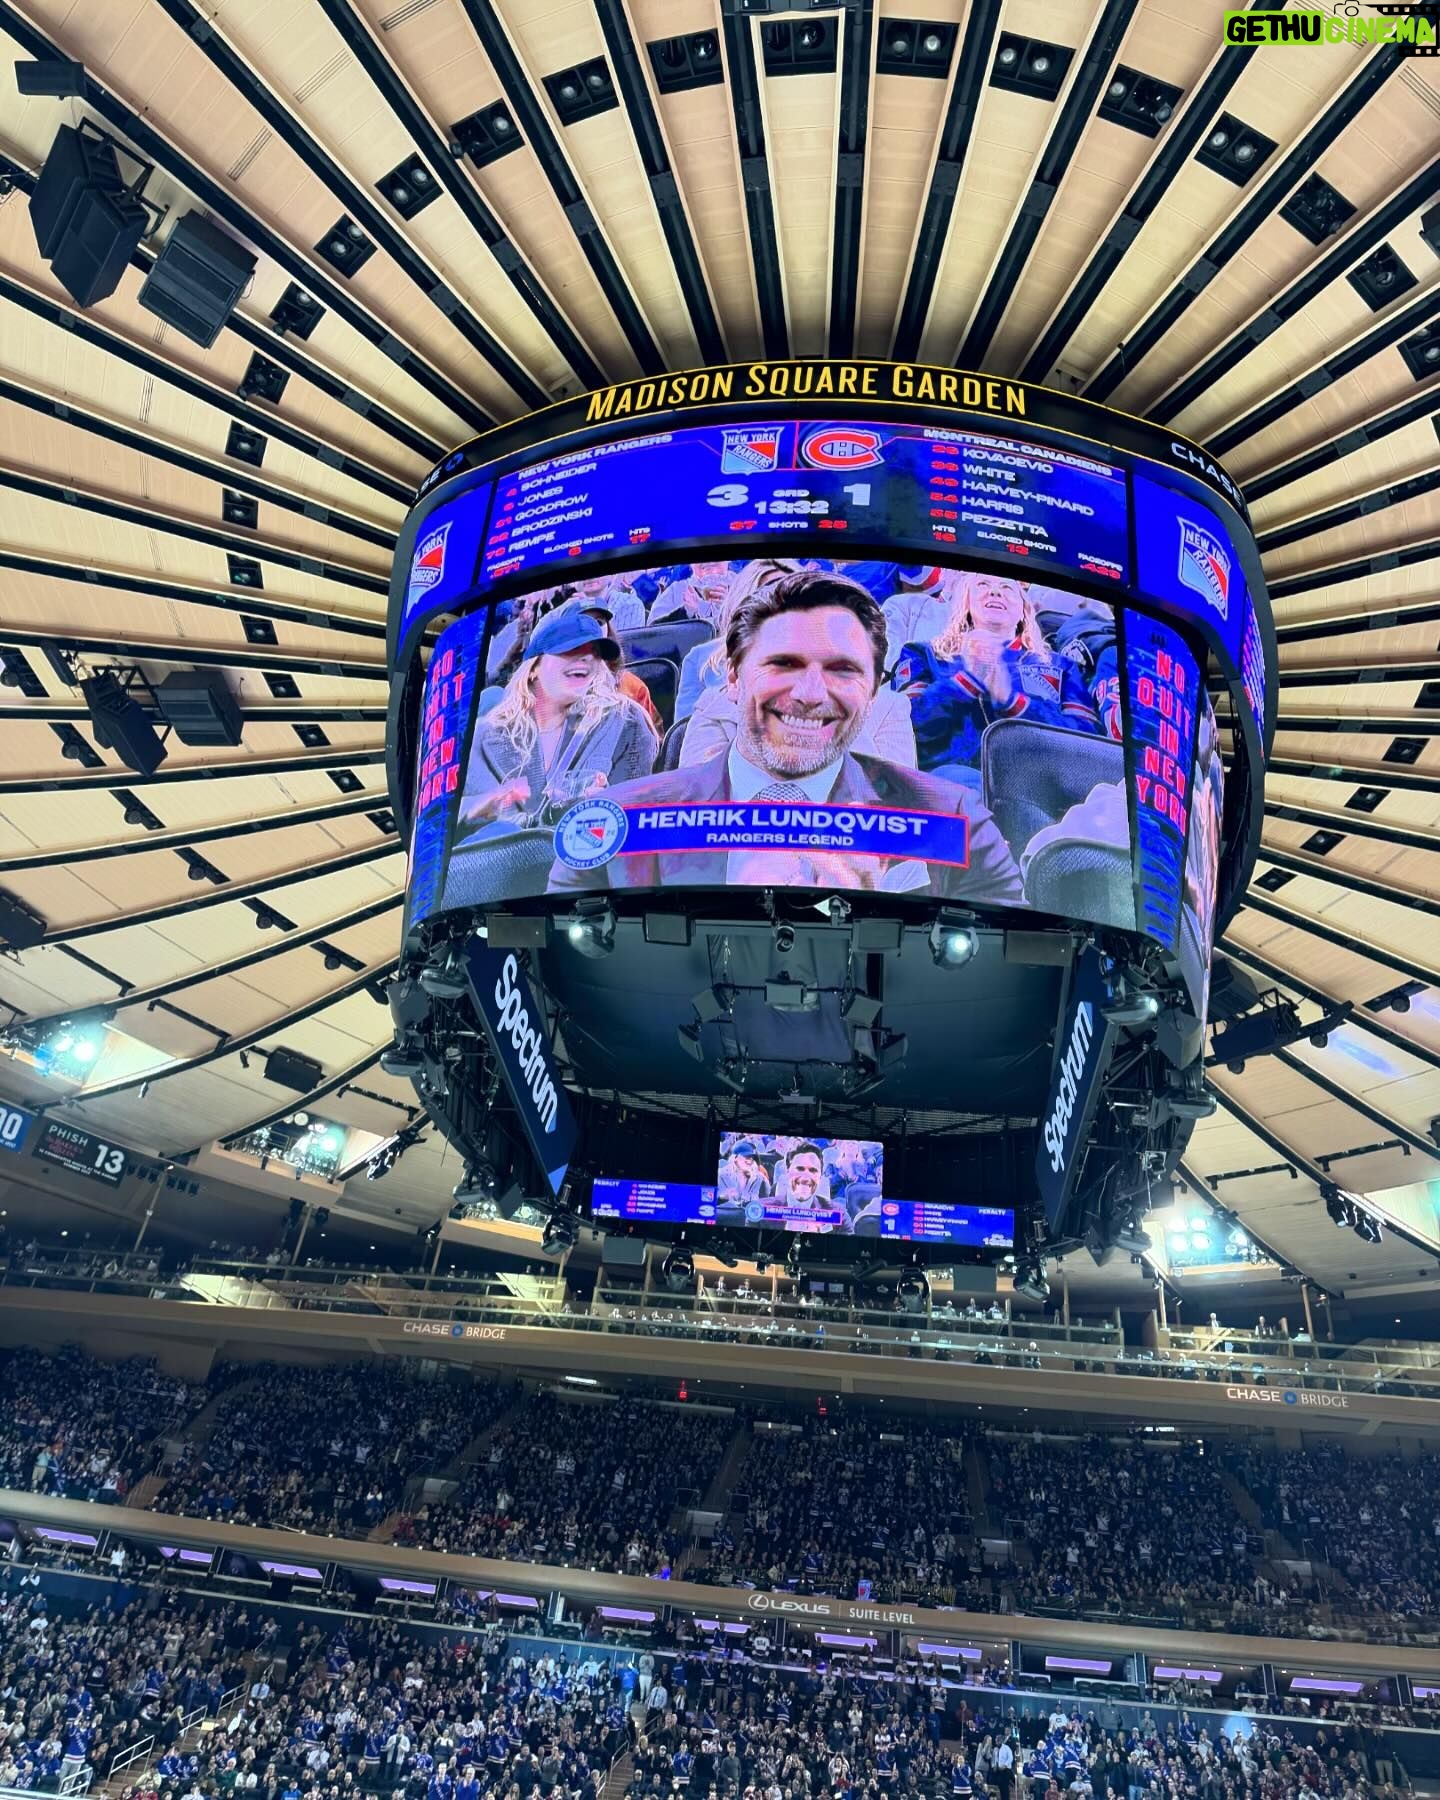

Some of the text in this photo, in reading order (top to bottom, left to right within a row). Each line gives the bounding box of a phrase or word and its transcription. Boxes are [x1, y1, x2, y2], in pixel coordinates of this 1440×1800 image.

[586, 364, 1026, 421] MADISON SQUARE GARDEN
[727, 432, 775, 444] NEW YORK
[518, 434, 673, 480] NEW YORK RANGERS
[733, 445, 773, 469] RANGERS
[923, 429, 1112, 477] MONTREAL CANADIENS
[521, 462, 597, 492] SCHNEIDER
[963, 463, 1016, 482] WHITE
[1171, 442, 1241, 506] CHASE
[517, 486, 564, 507] JONES
[706, 483, 871, 507] 3 1
[754, 500, 830, 514] 13:32
[962, 479, 1095, 517] HARVEY-PINARD
[962, 495, 1024, 515] HARRIS
[515, 493, 589, 522] GOODROW
[512, 507, 593, 537] BRODZINSKI
[629, 527, 650, 537] HITS
[768, 521, 808, 529] SHOTS
[932, 524, 956, 533] HITS
[961, 511, 1049, 537] PEZZETTA
[508, 531, 556, 553] REMPE
[544, 533, 614, 554] BLOCKED SHOTS
[977, 531, 1057, 552] BLOCKED SHOTS
[1186, 529, 1210, 550] NEW
[1157, 649, 1185, 694] NO
[1137, 677, 1191, 738] QUIT
[1160, 719, 1179, 757] IN
[1145, 746, 1185, 799] NEW
[638, 807, 929, 836] HENRIK LUNDQVIST
[706, 832, 855, 847] RANGERS LEGEND
[495, 953, 558, 1134] Spectrum
[1044, 1001, 1093, 1174] Spectrum
[49, 1124, 89, 1147] PHISH
[94, 1144, 125, 1174] 13
[403, 1322, 506, 1340] CHASE BRIDGE
[1226, 1388, 1349, 1408] CHASE BRIDGE
[771, 1600, 915, 1624] LEXUS SUITE LEVEL
